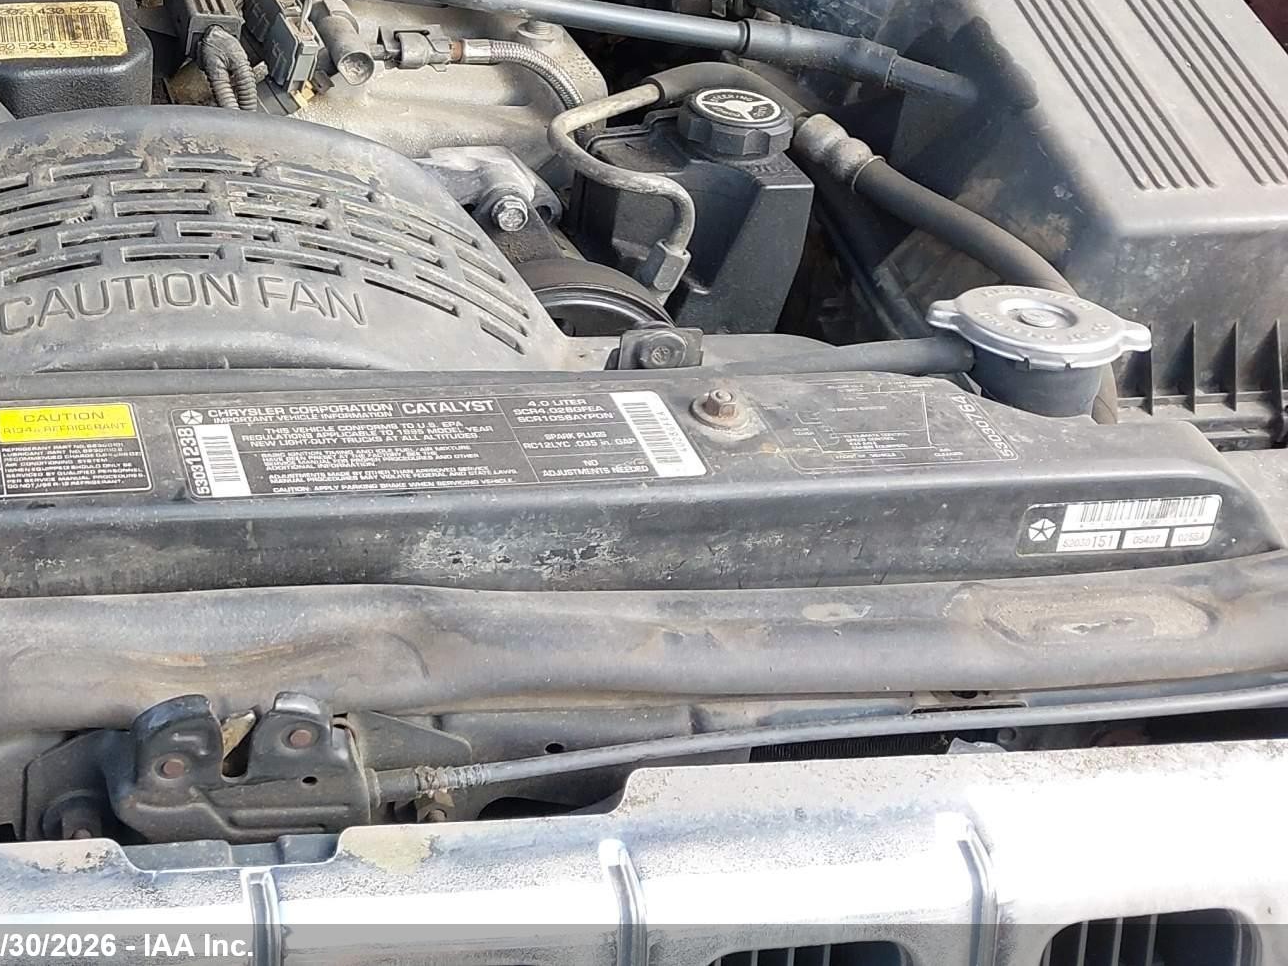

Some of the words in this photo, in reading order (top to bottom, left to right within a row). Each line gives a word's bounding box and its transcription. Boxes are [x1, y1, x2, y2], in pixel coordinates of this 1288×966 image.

[258, 275, 366, 326] FAN
[208, 407, 285, 418] CHRYSLER
[289, 403, 393, 414] CORPORATION
[402, 400, 494, 414] CATALYST
[23, 411, 104, 423] CAUTION
[213, 416, 274, 424] IMPORTANT
[320, 411, 392, 420] INFORMATION
[43, 422, 128, 433] REFRIGERANT
[337, 423, 399, 432] CONFORMS
[241, 433, 313, 442] REGULATIONS
[316, 431, 377, 439] APPLICABLE
[576, 431, 607, 439] PLUGS
[280, 437, 338, 446] LIGHT-DUTY
[341, 436, 383, 444] TRUCKS
[615, 437, 636, 445] GAP
[582, 459, 599, 467] NO
[543, 467, 611, 477] ADJUSTMENTS
[611, 465, 649, 473] NEEDED
